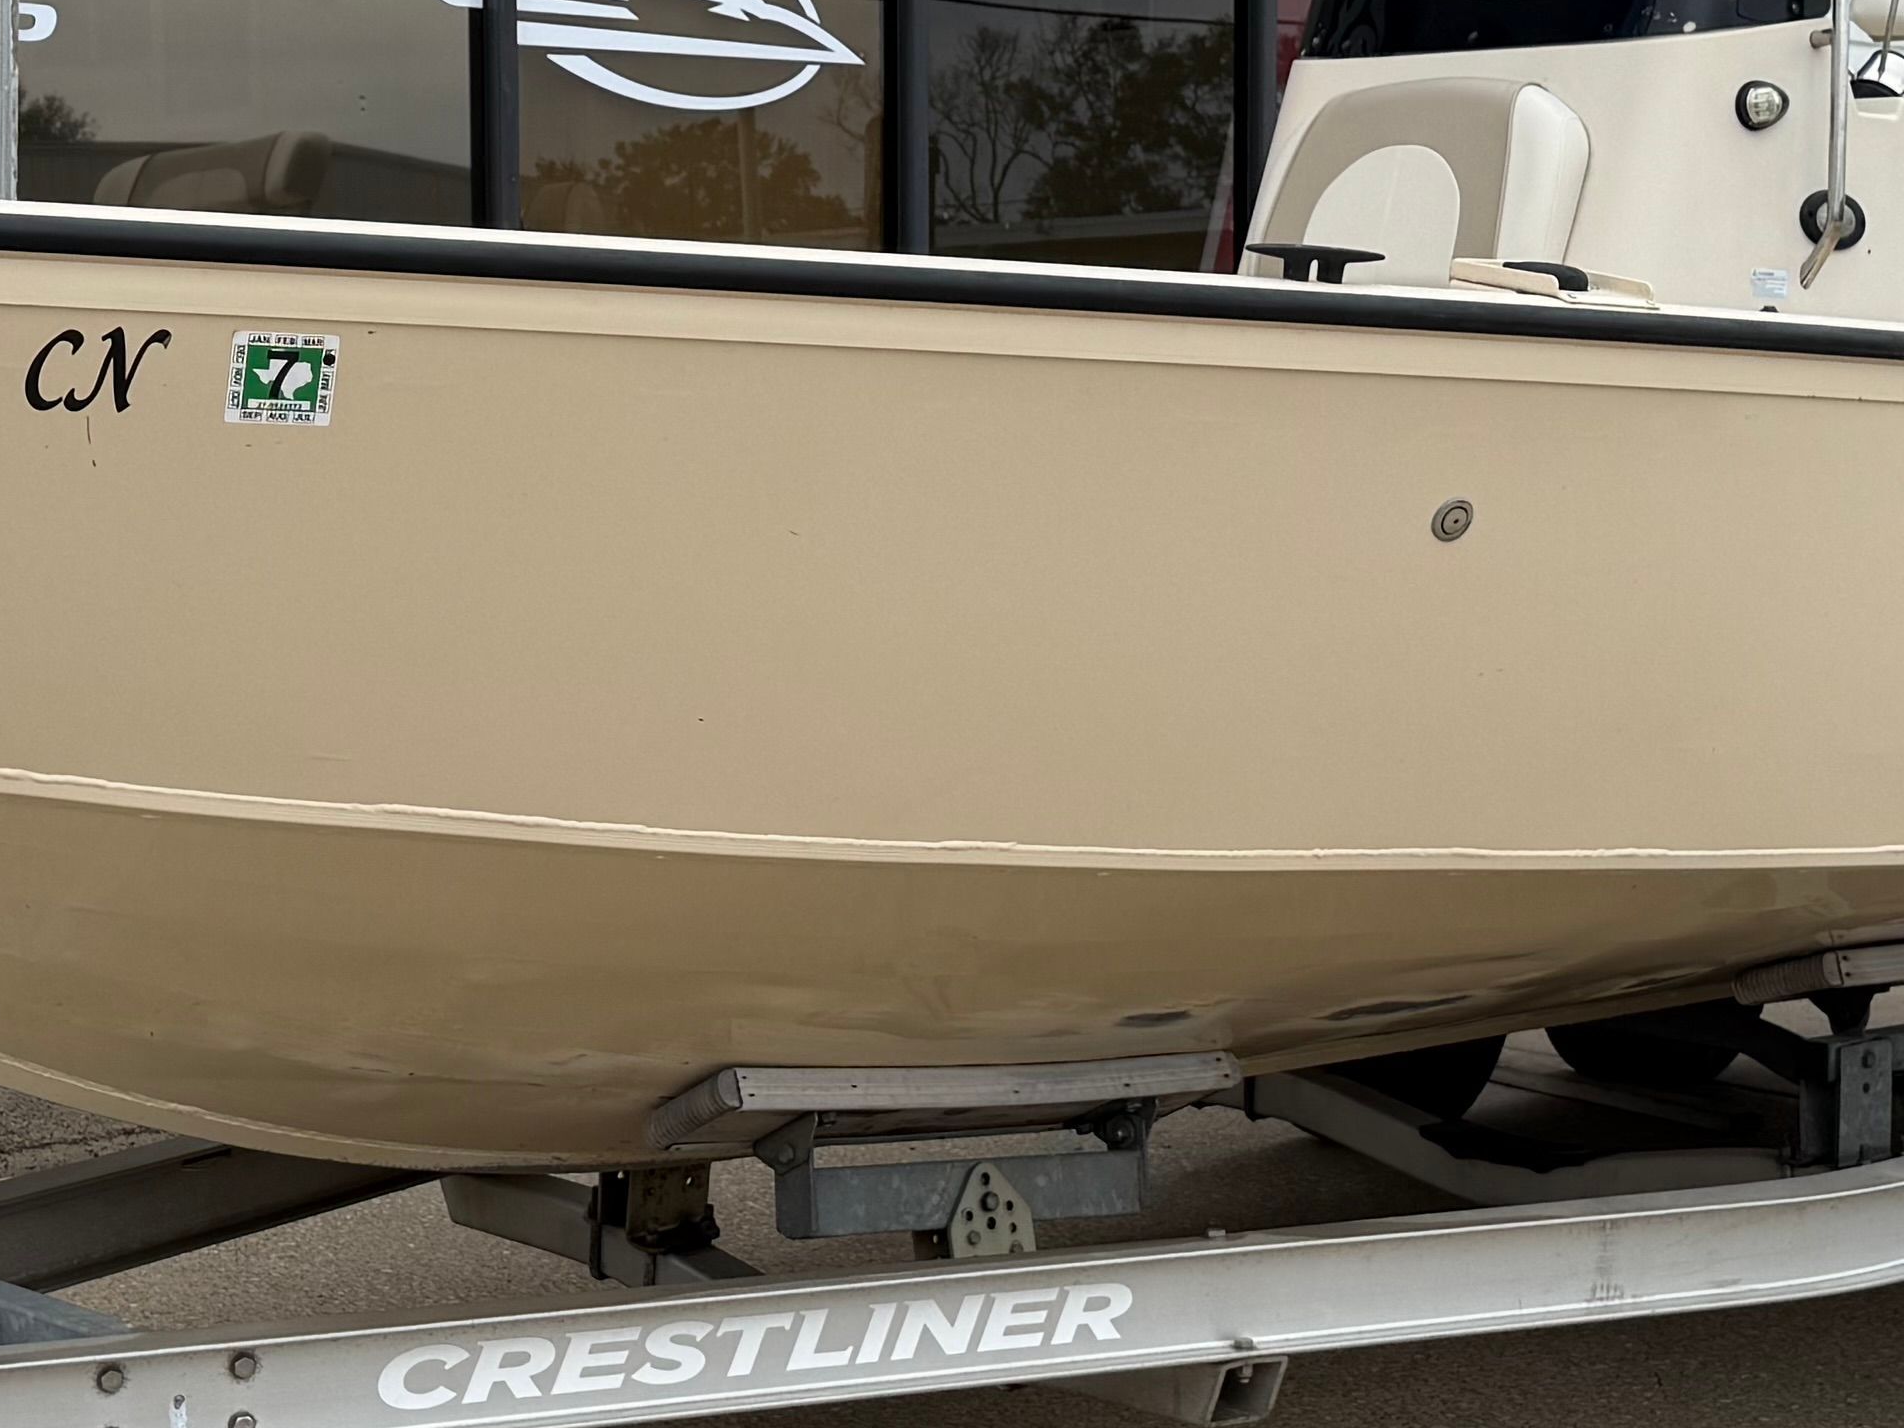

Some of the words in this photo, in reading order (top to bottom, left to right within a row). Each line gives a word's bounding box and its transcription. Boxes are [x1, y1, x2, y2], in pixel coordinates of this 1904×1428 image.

[24, 328, 172, 413] CN
[249, 333, 271, 344] JAN
[267, 349, 301, 400] 7
[377, 1281, 1134, 1412] CRESTLINER
